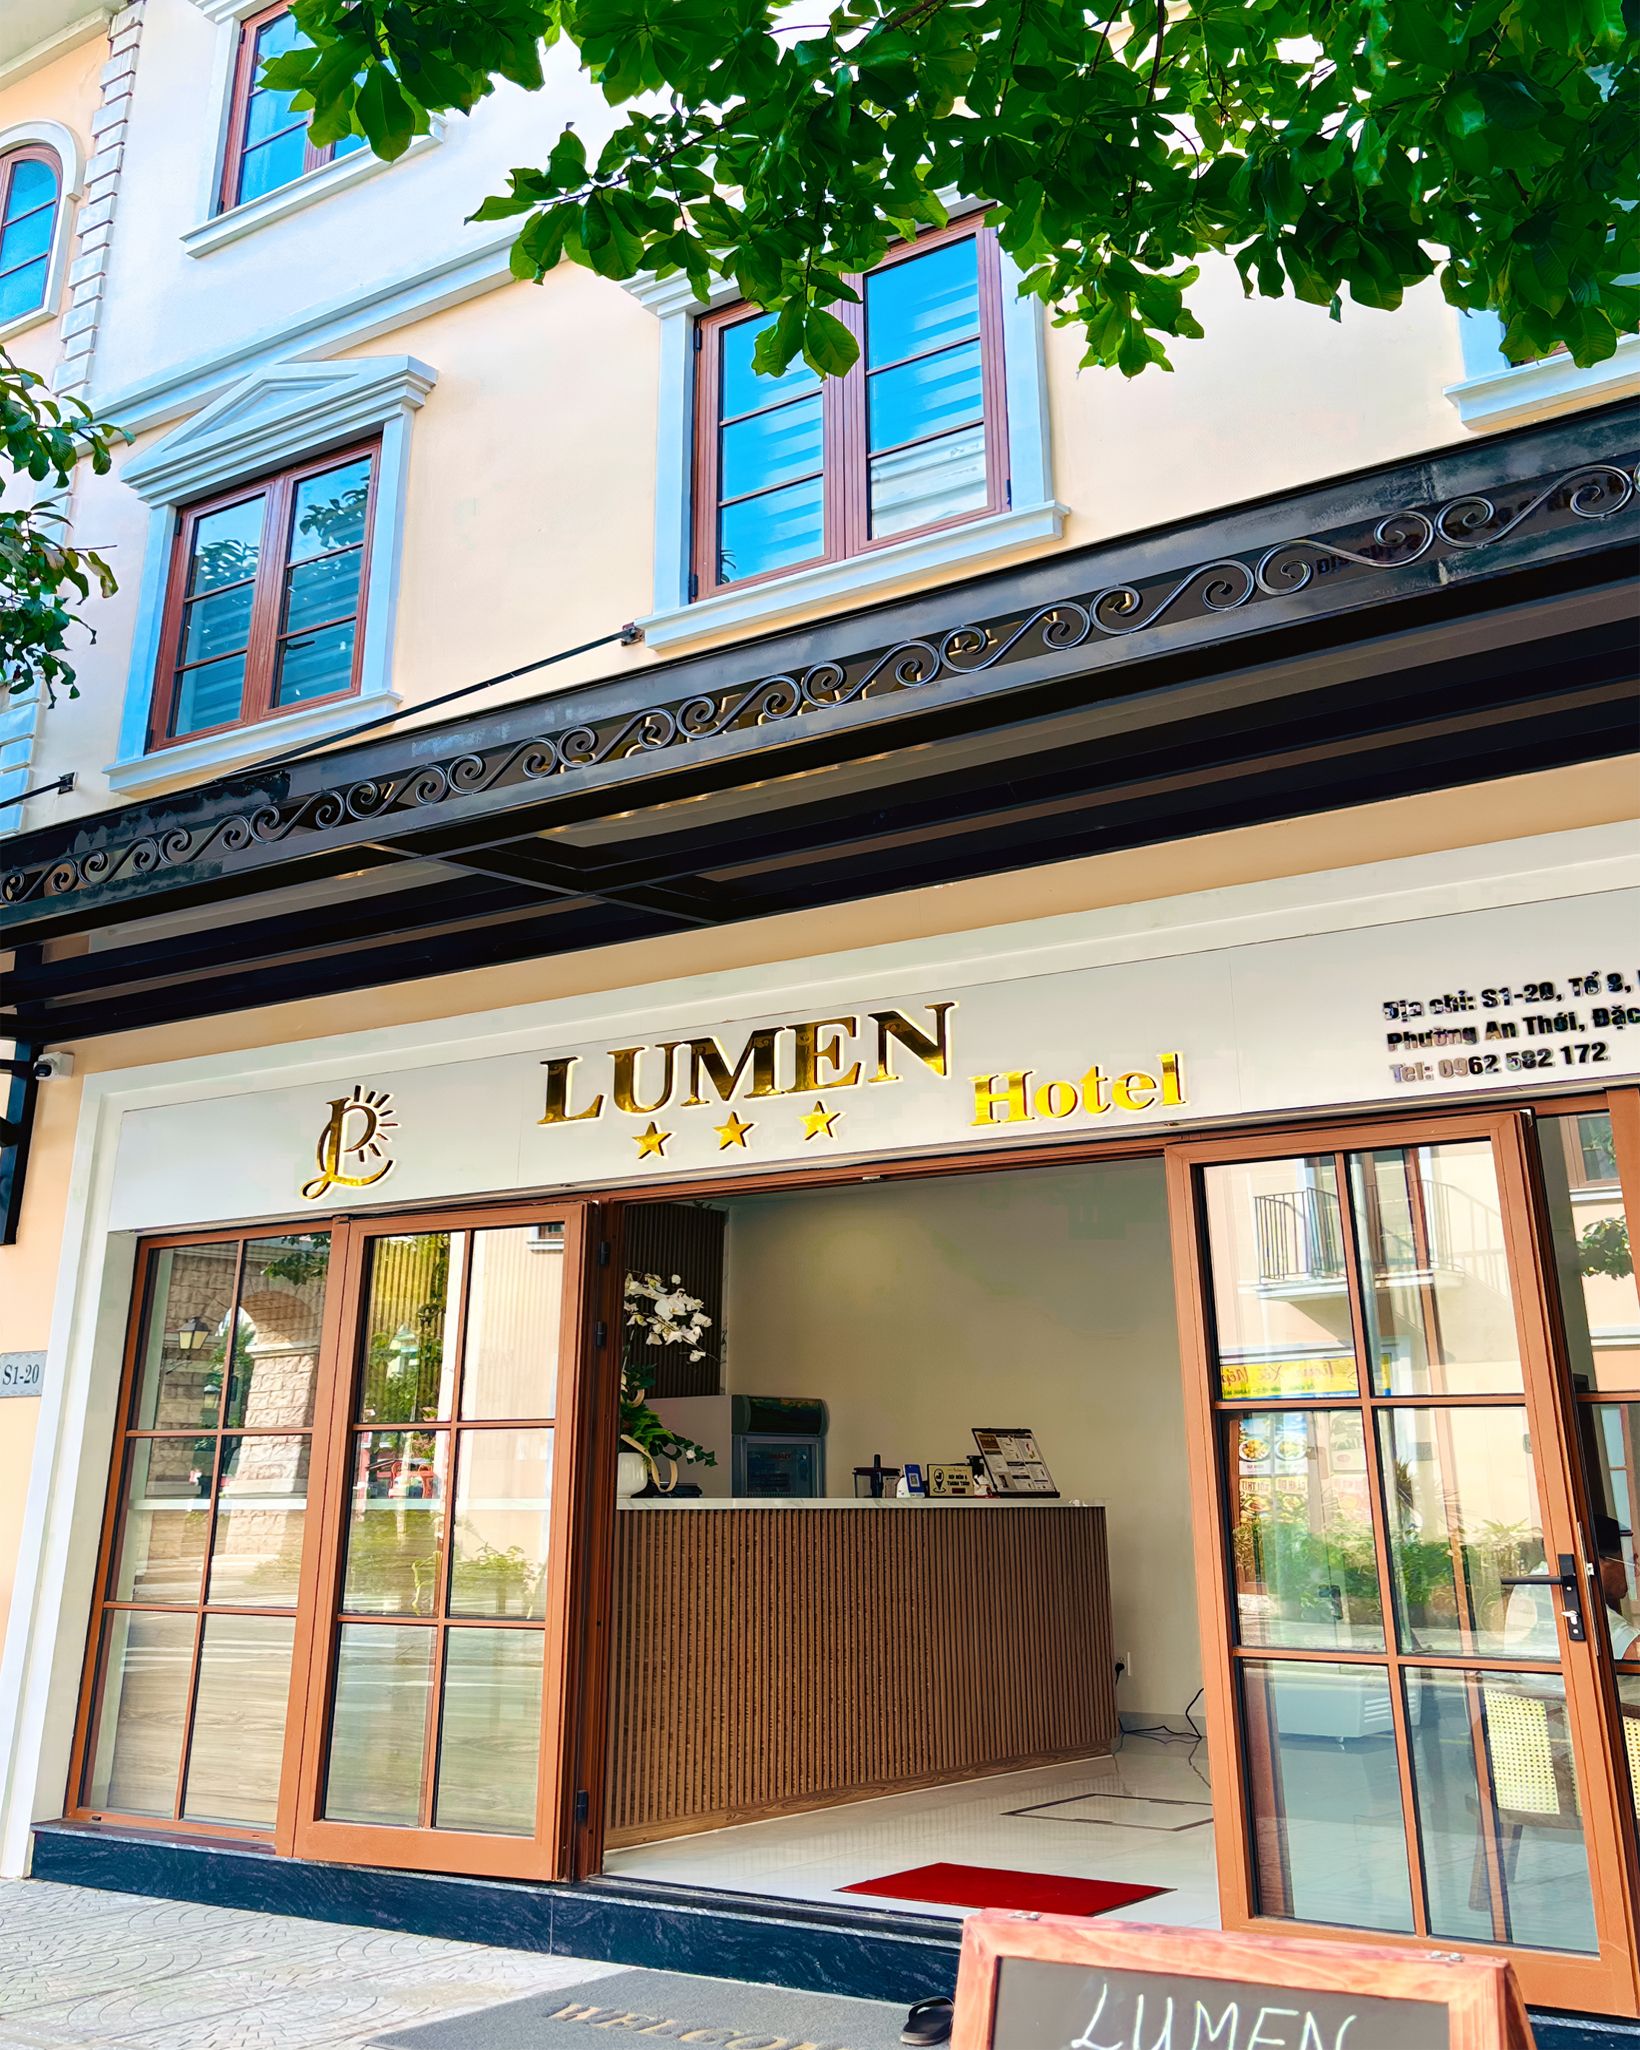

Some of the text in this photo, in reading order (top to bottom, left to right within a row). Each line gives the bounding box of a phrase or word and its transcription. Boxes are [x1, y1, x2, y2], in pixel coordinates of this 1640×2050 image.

[1482, 980, 1563, 1009] S1-20,
[1485, 1020, 1516, 1040] An
[537, 1001, 957, 1126] LUMEN
[1390, 1060, 1433, 1083] Tel:
[1438, 1054, 1501, 1078] 0962
[1560, 1041, 1608, 1065] 172
[970, 1053, 1187, 1126] Hotel
[2, 1363, 40, 1386] S1-20
[543, 2001, 850, 2050] WELCO
